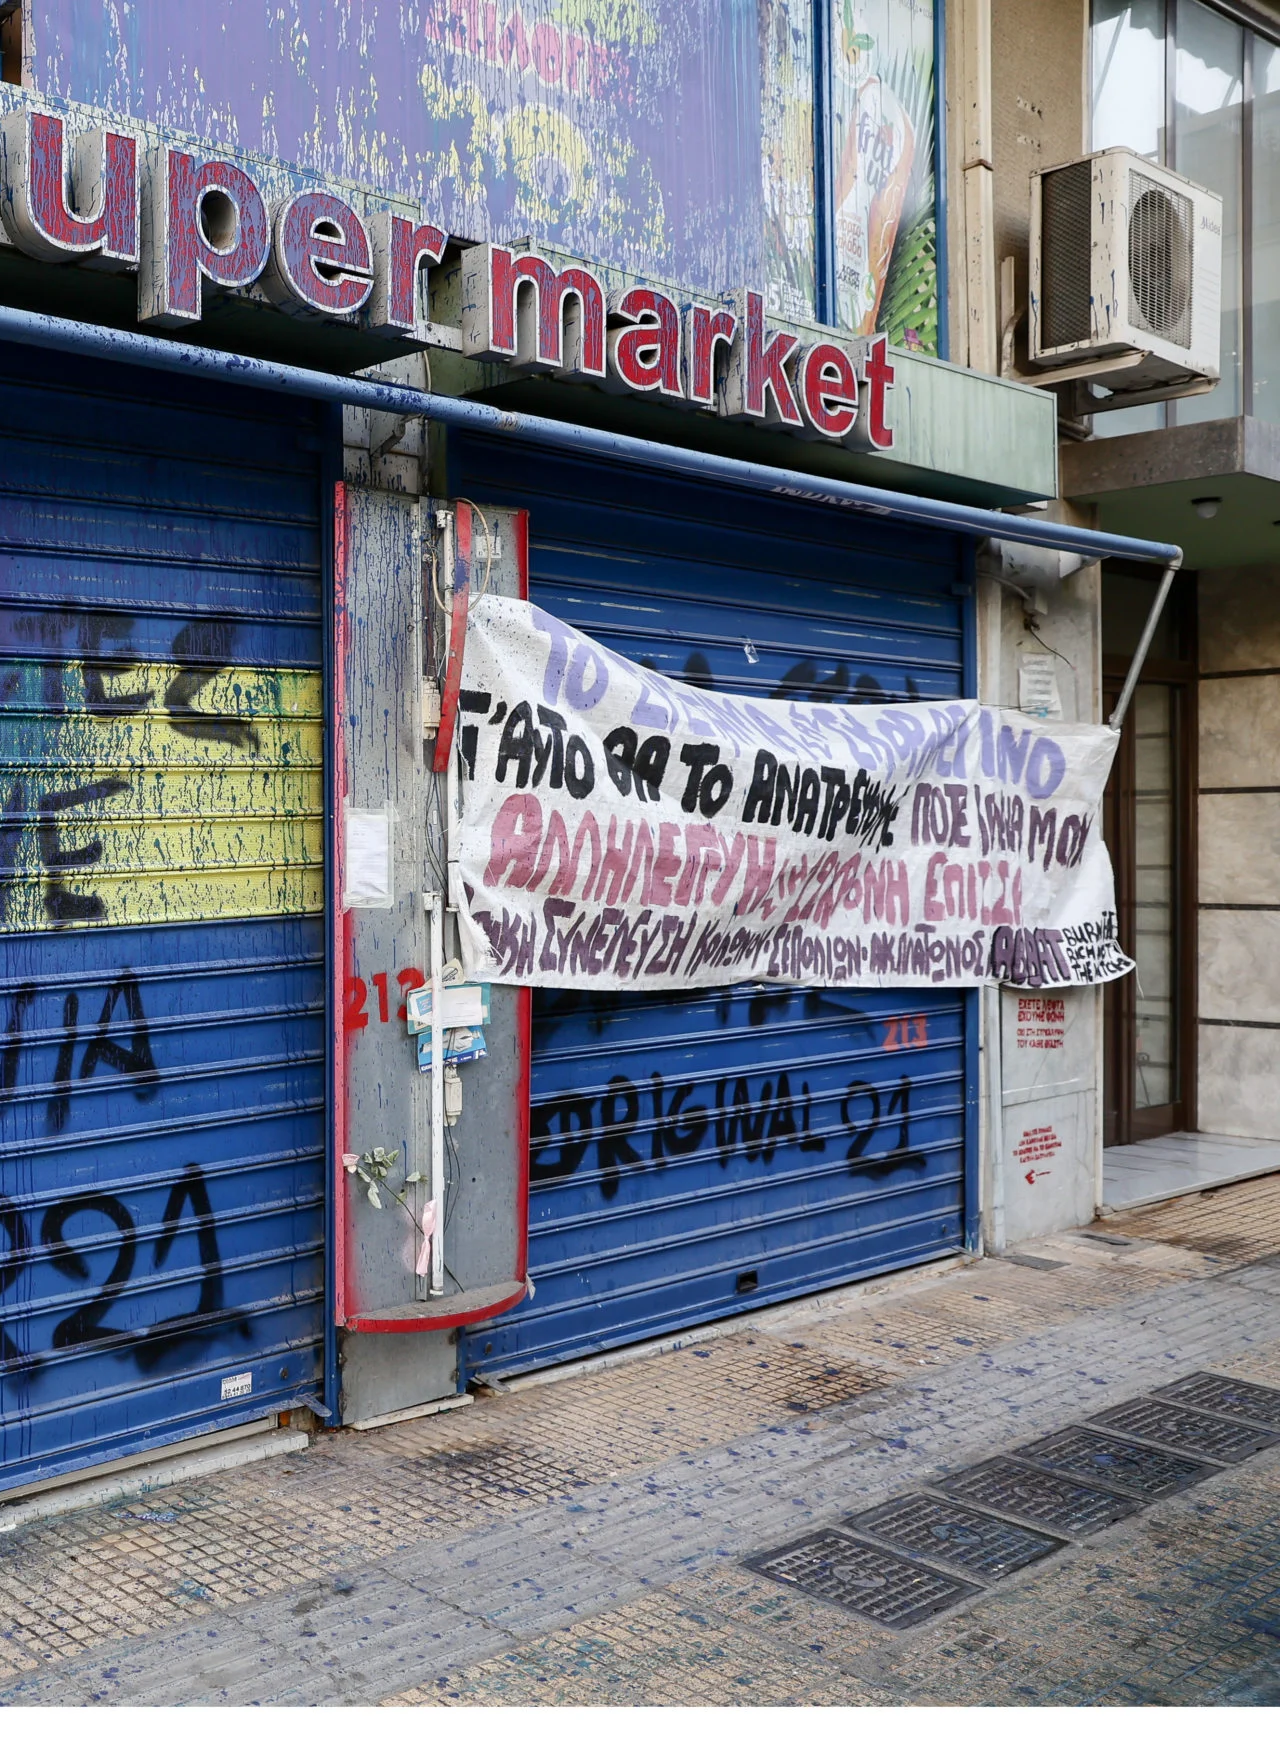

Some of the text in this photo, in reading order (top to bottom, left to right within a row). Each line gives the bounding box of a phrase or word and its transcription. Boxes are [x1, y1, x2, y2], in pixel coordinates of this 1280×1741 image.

[487, 242, 897, 453] market
[531, 607, 609, 711] ΤΟ
[603, 726, 670, 801] ΘΑ
[681, 743, 733, 819] ΤΟ
[910, 783, 971, 848] ΠΟΤΕ
[1066, 945, 1095, 961] RICH
[1072, 961, 1094, 982] THE
[883, 1013, 928, 1052] 213
